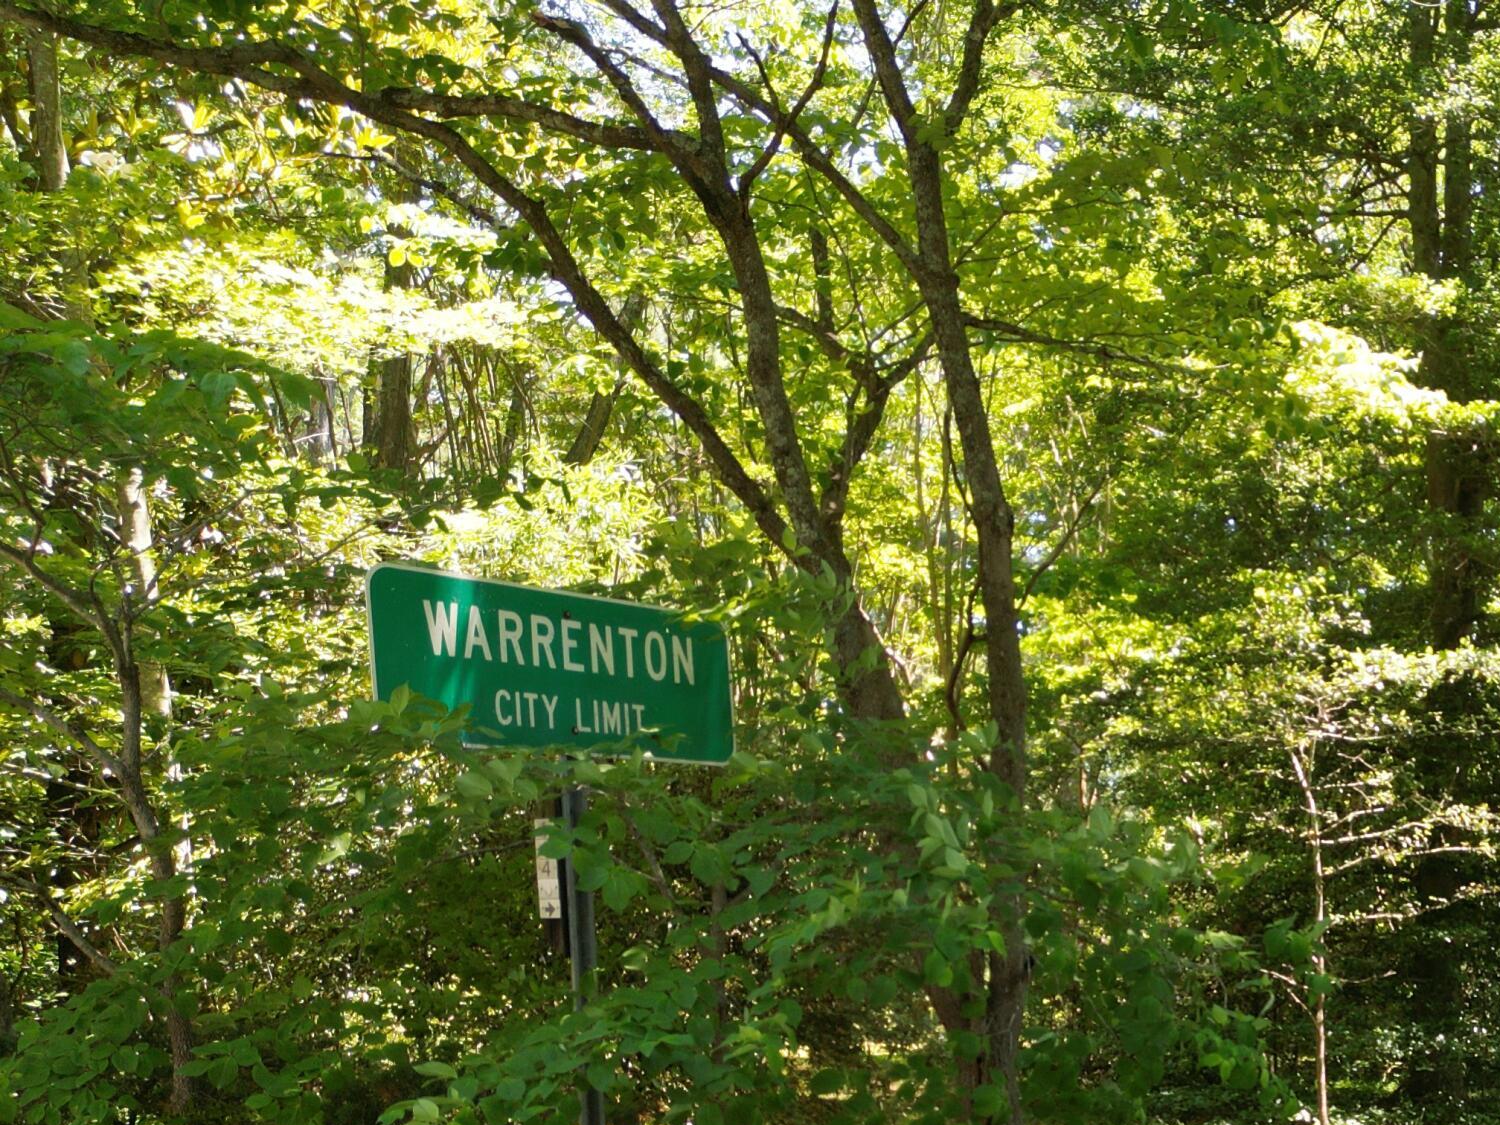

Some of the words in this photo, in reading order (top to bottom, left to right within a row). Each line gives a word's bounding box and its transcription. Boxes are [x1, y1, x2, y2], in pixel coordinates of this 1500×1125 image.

[423, 600, 695, 685] WARRENTON
[495, 689, 558, 729] CITY
[576, 698, 645, 736] LIMIT
